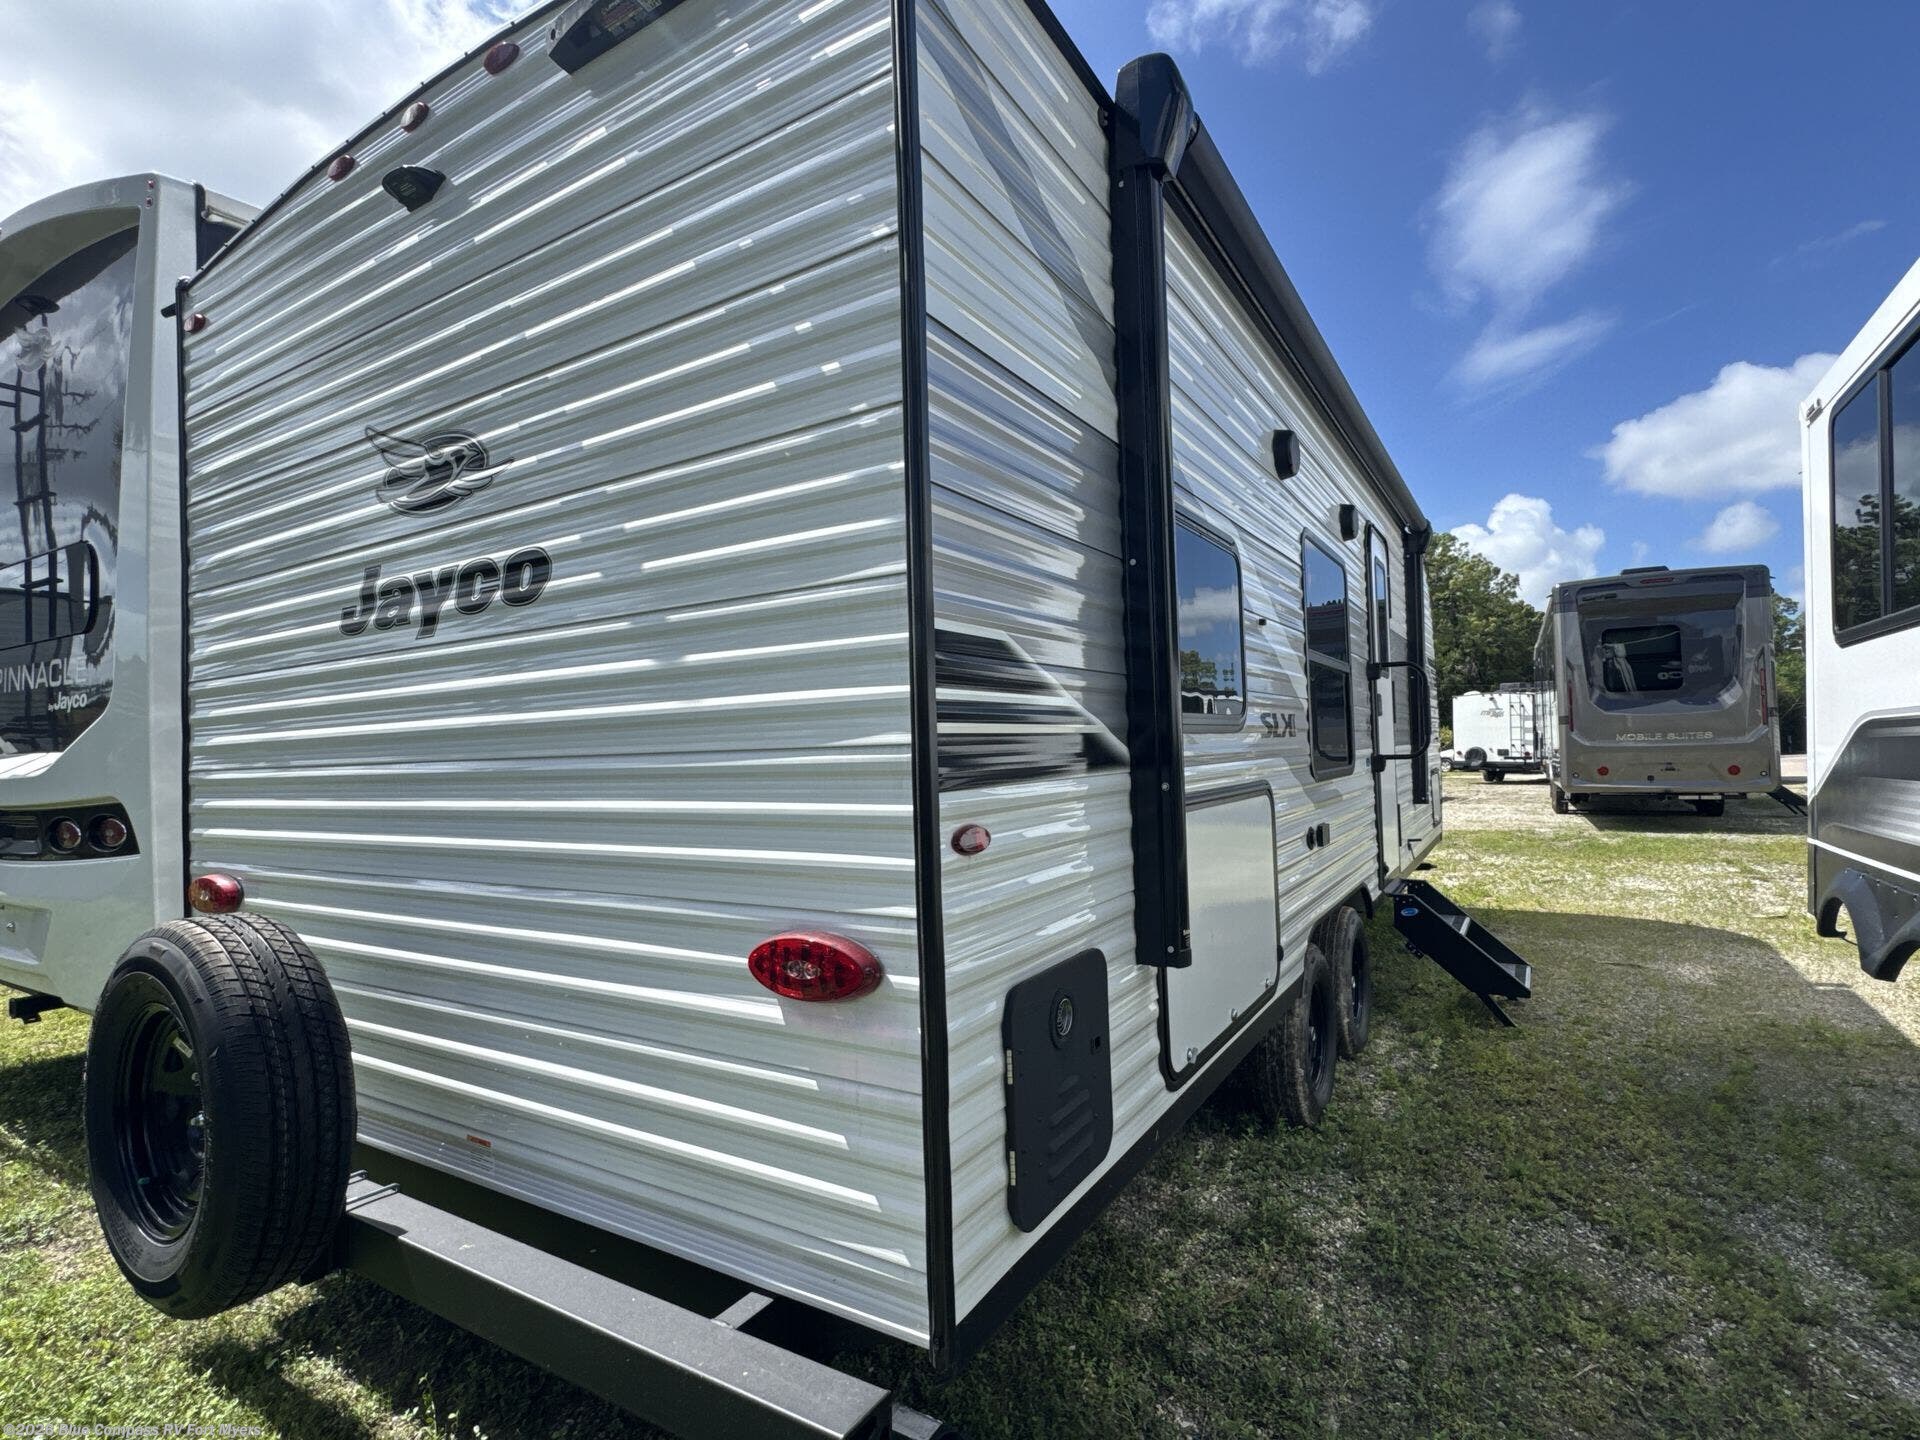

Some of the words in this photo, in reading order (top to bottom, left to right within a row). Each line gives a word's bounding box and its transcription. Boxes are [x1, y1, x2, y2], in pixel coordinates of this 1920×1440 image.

[338, 546, 553, 640] Jayco
[54, 692, 87, 713] Jayco
[1615, 733, 1663, 741] MOBILE
[1666, 731, 1713, 740] SUITES
